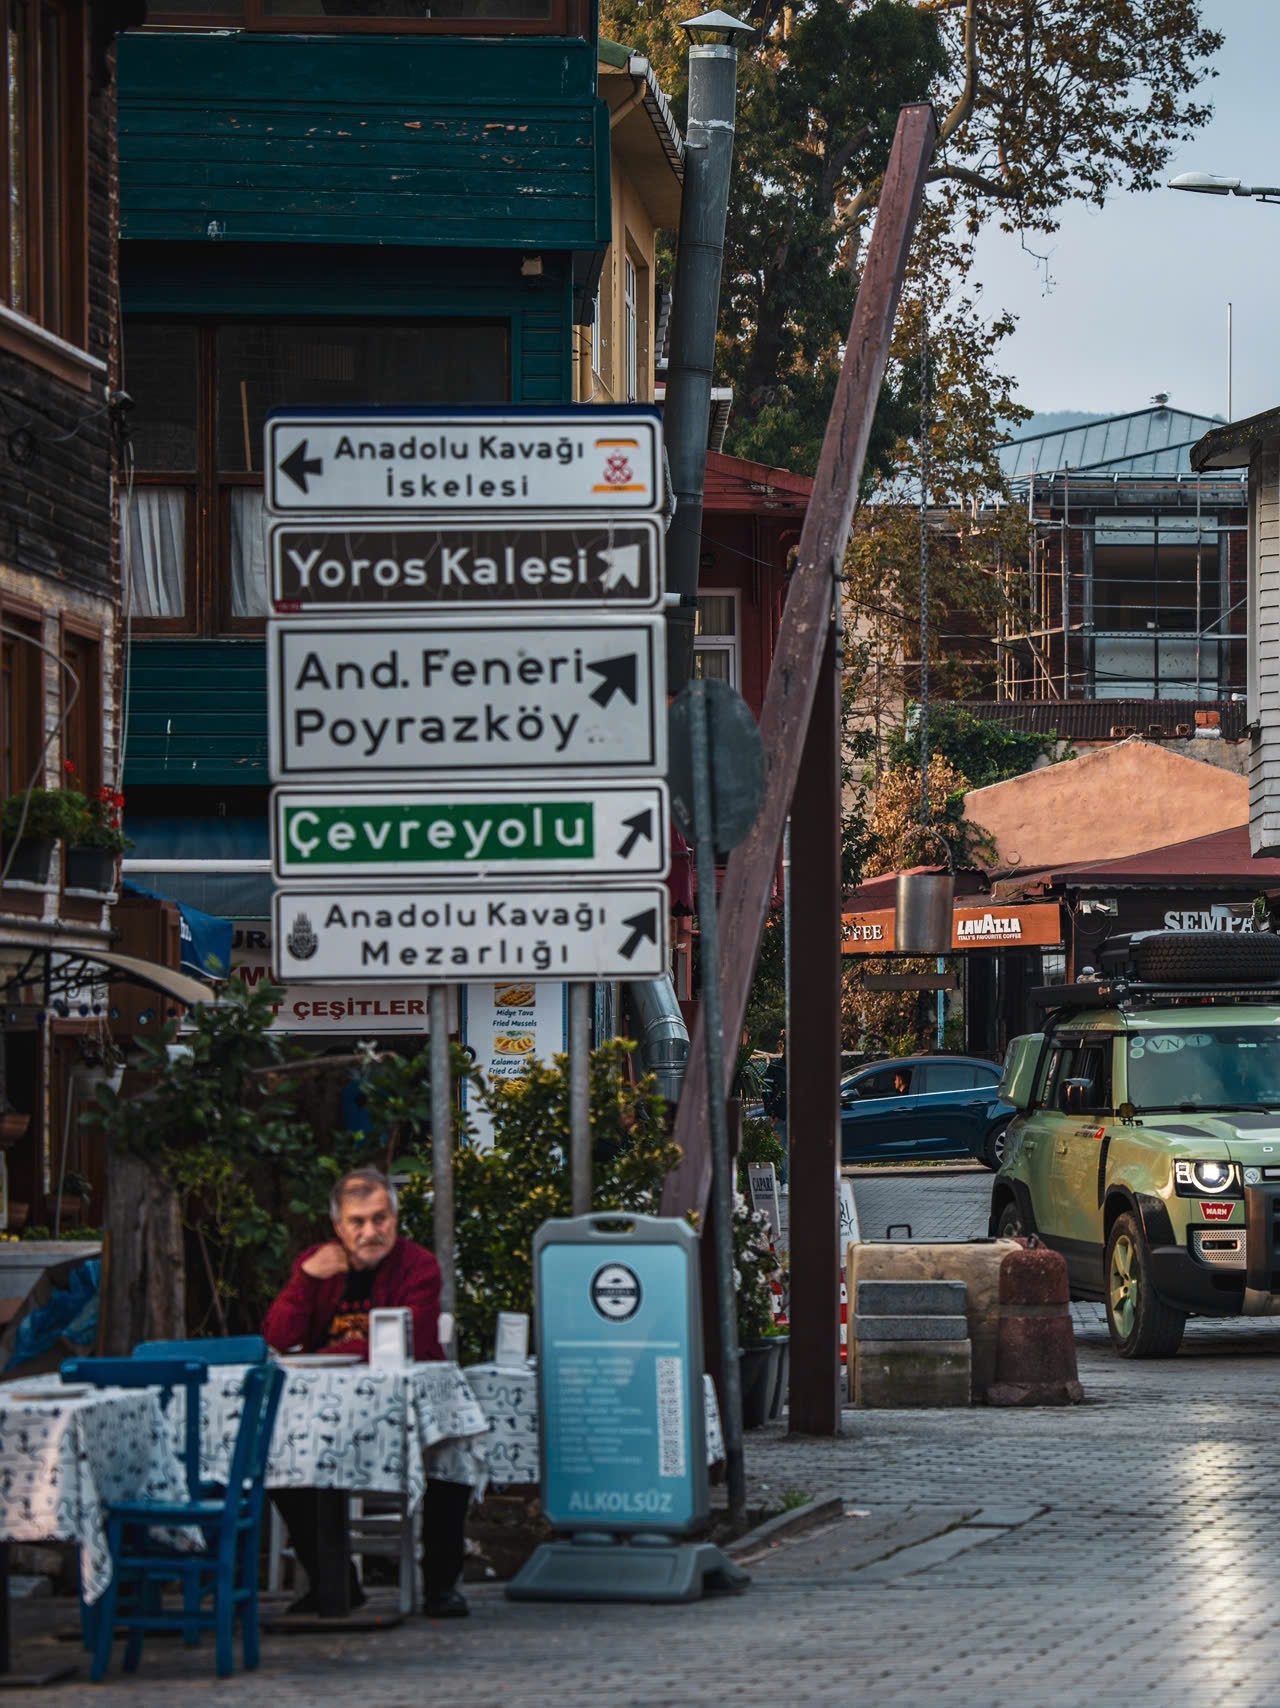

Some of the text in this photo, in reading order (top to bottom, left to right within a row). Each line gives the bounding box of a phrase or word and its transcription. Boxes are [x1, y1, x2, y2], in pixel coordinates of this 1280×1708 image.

[334, 436, 583, 465] Anadolu Kavağı
[387, 468, 528, 497] İskelesi
[288, 547, 588, 588] Yoros Kalesi
[295, 648, 583, 690] And. Feneri
[295, 704, 580, 756] Poyrazköy
[288, 807, 585, 858] Çevreyolu
[324, 901, 606, 931] Anadolu Kavağı
[957, 914, 1022, 935] LAVAZZA
[1164, 911, 1255, 934] SEMPA
[842, 924, 883, 942] FFEE
[361, 939, 568, 969] Mezarlığı
[1152, 1040, 1180, 1050] VN
[1206, 1208, 1228, 1216] WARN
[568, 1488, 673, 1513] ALKOLSÜZ
